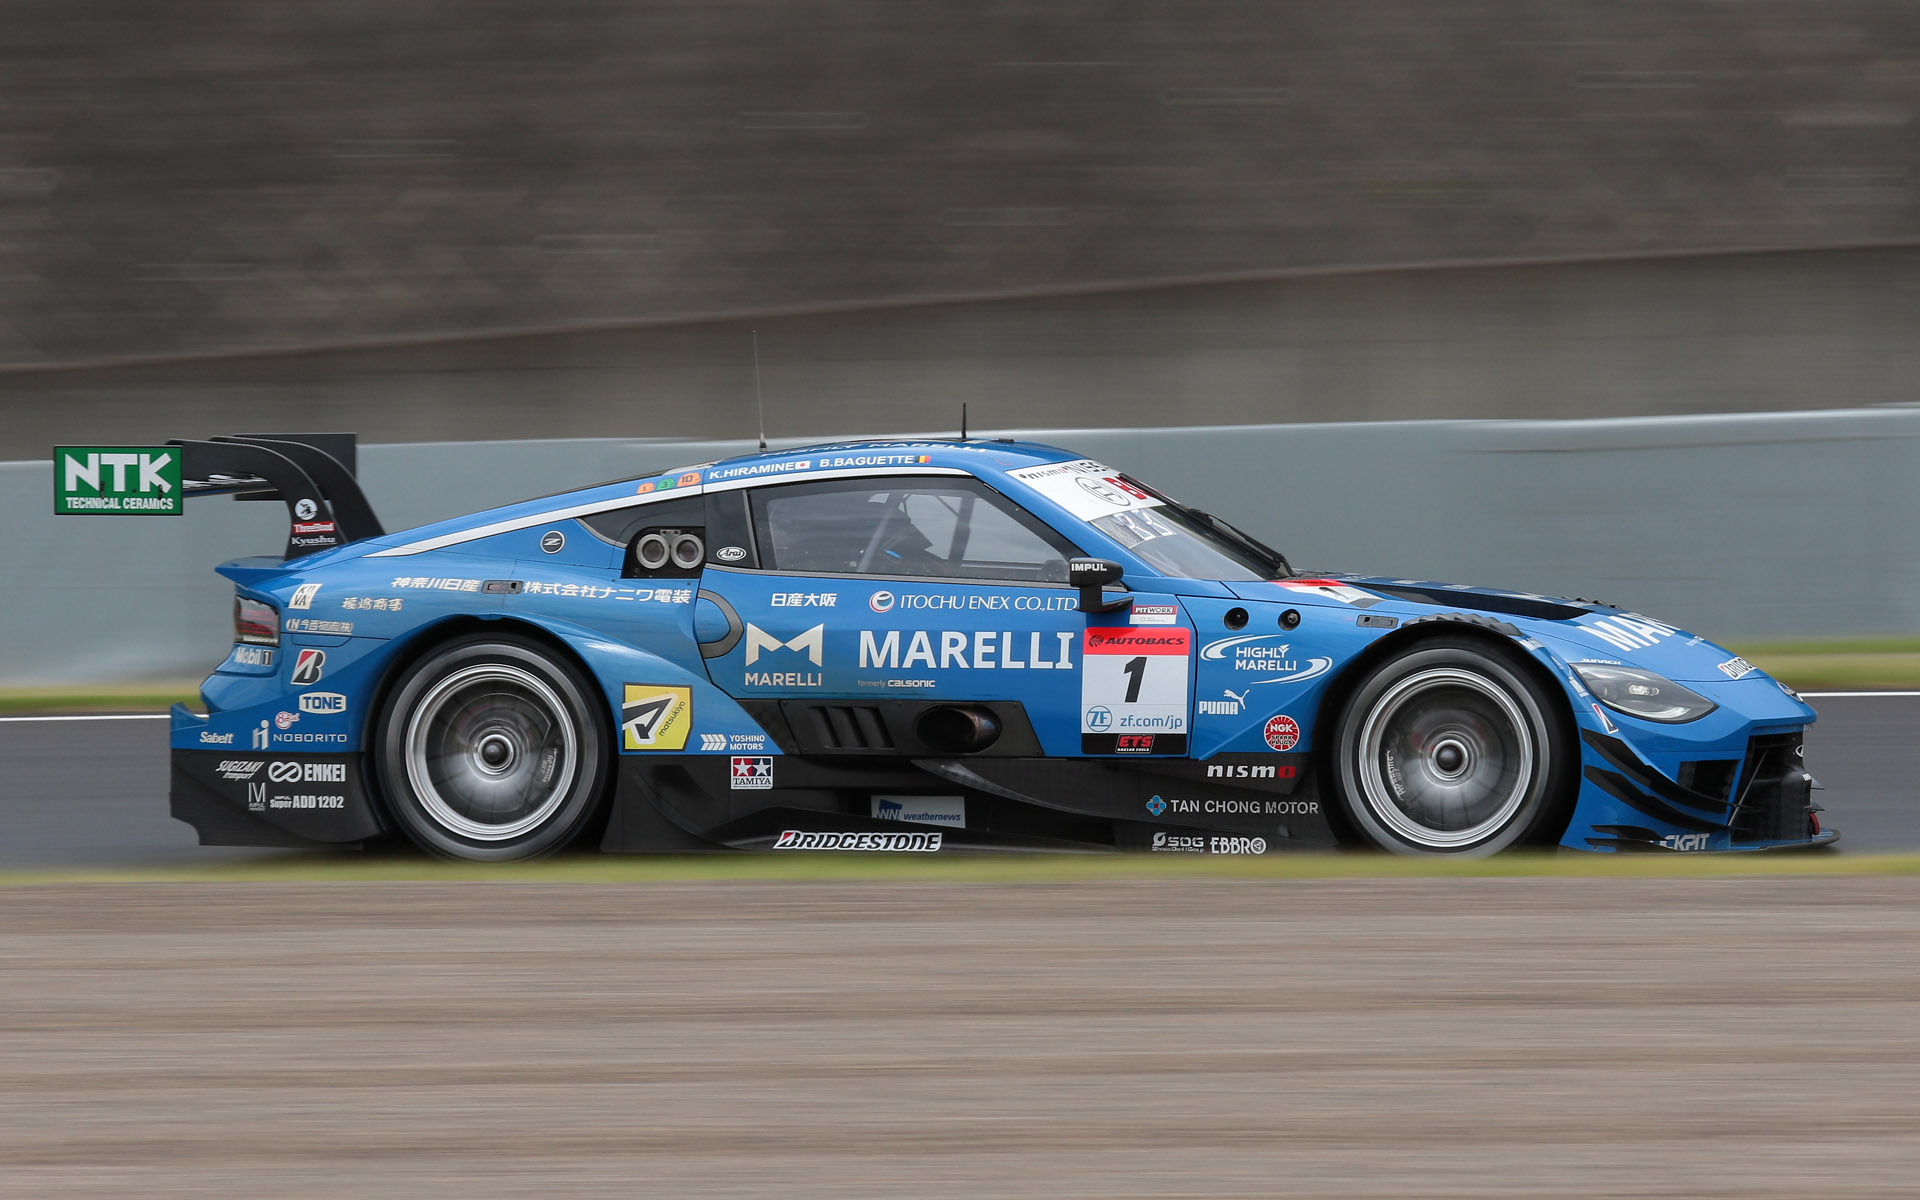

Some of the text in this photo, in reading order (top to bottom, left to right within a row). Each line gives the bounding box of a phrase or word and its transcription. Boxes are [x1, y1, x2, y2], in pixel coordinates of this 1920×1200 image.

[65, 453, 172, 493] NTK
[709, 455, 914, 479] K.HIRAMINE B.BAGUETTE
[66, 497, 174, 510] TECHNICAL CERAMICS
[292, 535, 336, 547] Kyushu
[1071, 563, 1107, 571] IMPUL
[391, 577, 692, 604] 神奈川日産 株式会社ナニワ電装
[771, 593, 837, 607] 日産大阪
[900, 594, 1078, 611] ITOCHU ENEX CO.,LTD
[1105, 637, 1184, 645] AUTOBACS
[234, 647, 261, 665] Mobil
[859, 630, 1076, 670] MARELLI
[1236, 644, 1290, 658] HIGHLY
[1235, 659, 1297, 671] MARELLI
[745, 673, 822, 687] MARELLI
[858, 680, 886, 688] formerly
[1124, 656, 1148, 703] 1
[303, 697, 342, 709] TONE
[1199, 701, 1239, 715] PUMA
[659, 701, 685, 736] matsukiyo
[1120, 715, 1182, 729] zf.com/jp
[1270, 724, 1293, 733] NGK
[273, 734, 347, 742] NOBORITO
[1119, 736, 1153, 748] ETS
[216, 761, 265, 772] SUGIZAKI
[304, 764, 346, 782] ENKEI
[1207, 765, 1296, 778] nismo
[270, 796, 344, 809] Super ADD 1202
[1171, 800, 1319, 814] TAN CHONG MOTOR
[904, 812, 961, 821] weathernews
[774, 832, 942, 850] BRIDGESTONE
[1168, 837, 1204, 847] SDG
[1210, 837, 1267, 854] EBBRO
